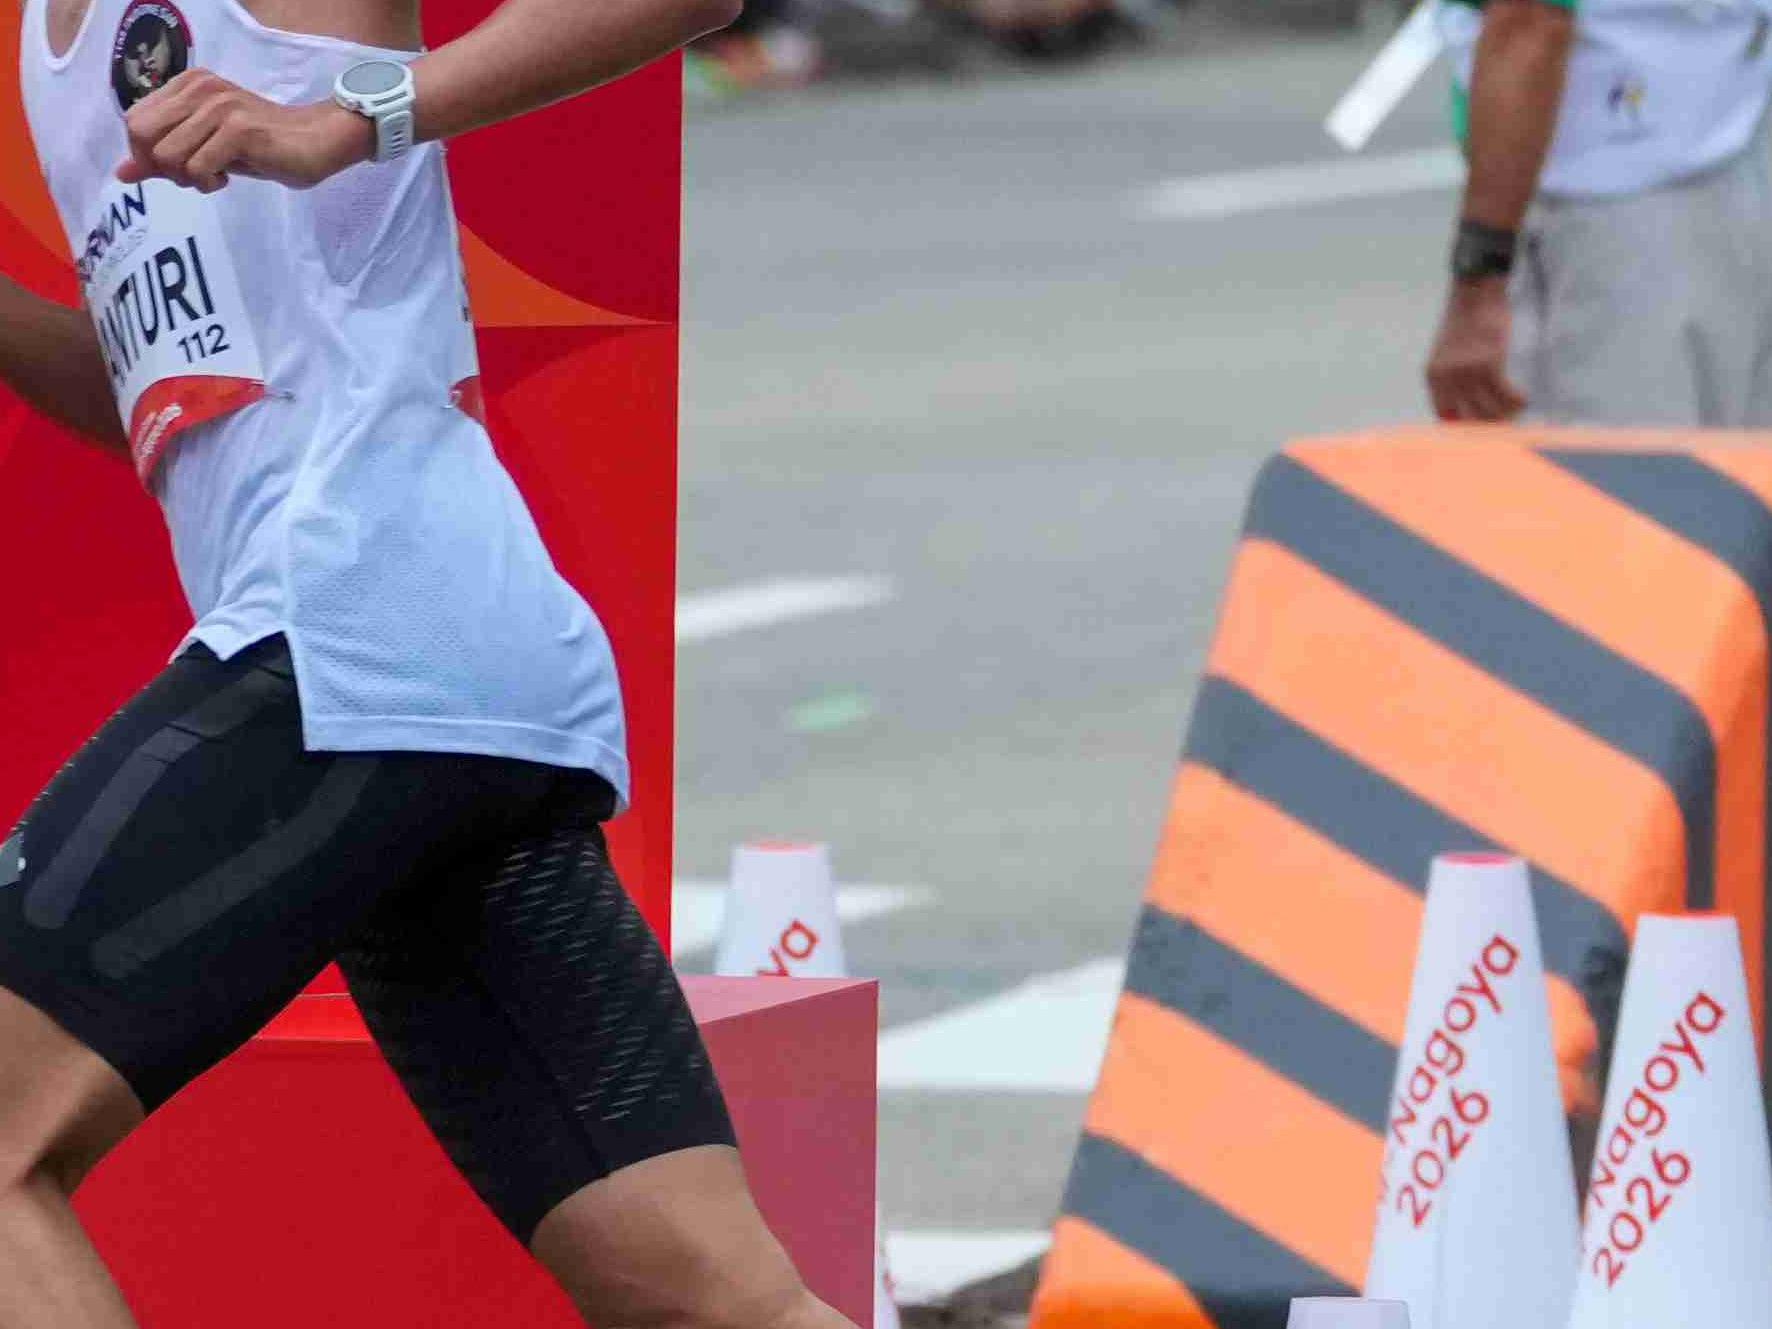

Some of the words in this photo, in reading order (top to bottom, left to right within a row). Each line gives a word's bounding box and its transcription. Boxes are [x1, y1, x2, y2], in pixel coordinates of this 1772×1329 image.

[176, 323, 231, 364] 112
[1390, 933, 1520, 1147] Nagoya
[1592, 990, 1727, 1208] Nagoya
[1396, 1085, 1492, 1229] 2026
[1593, 1148, 1693, 1289] 2026
